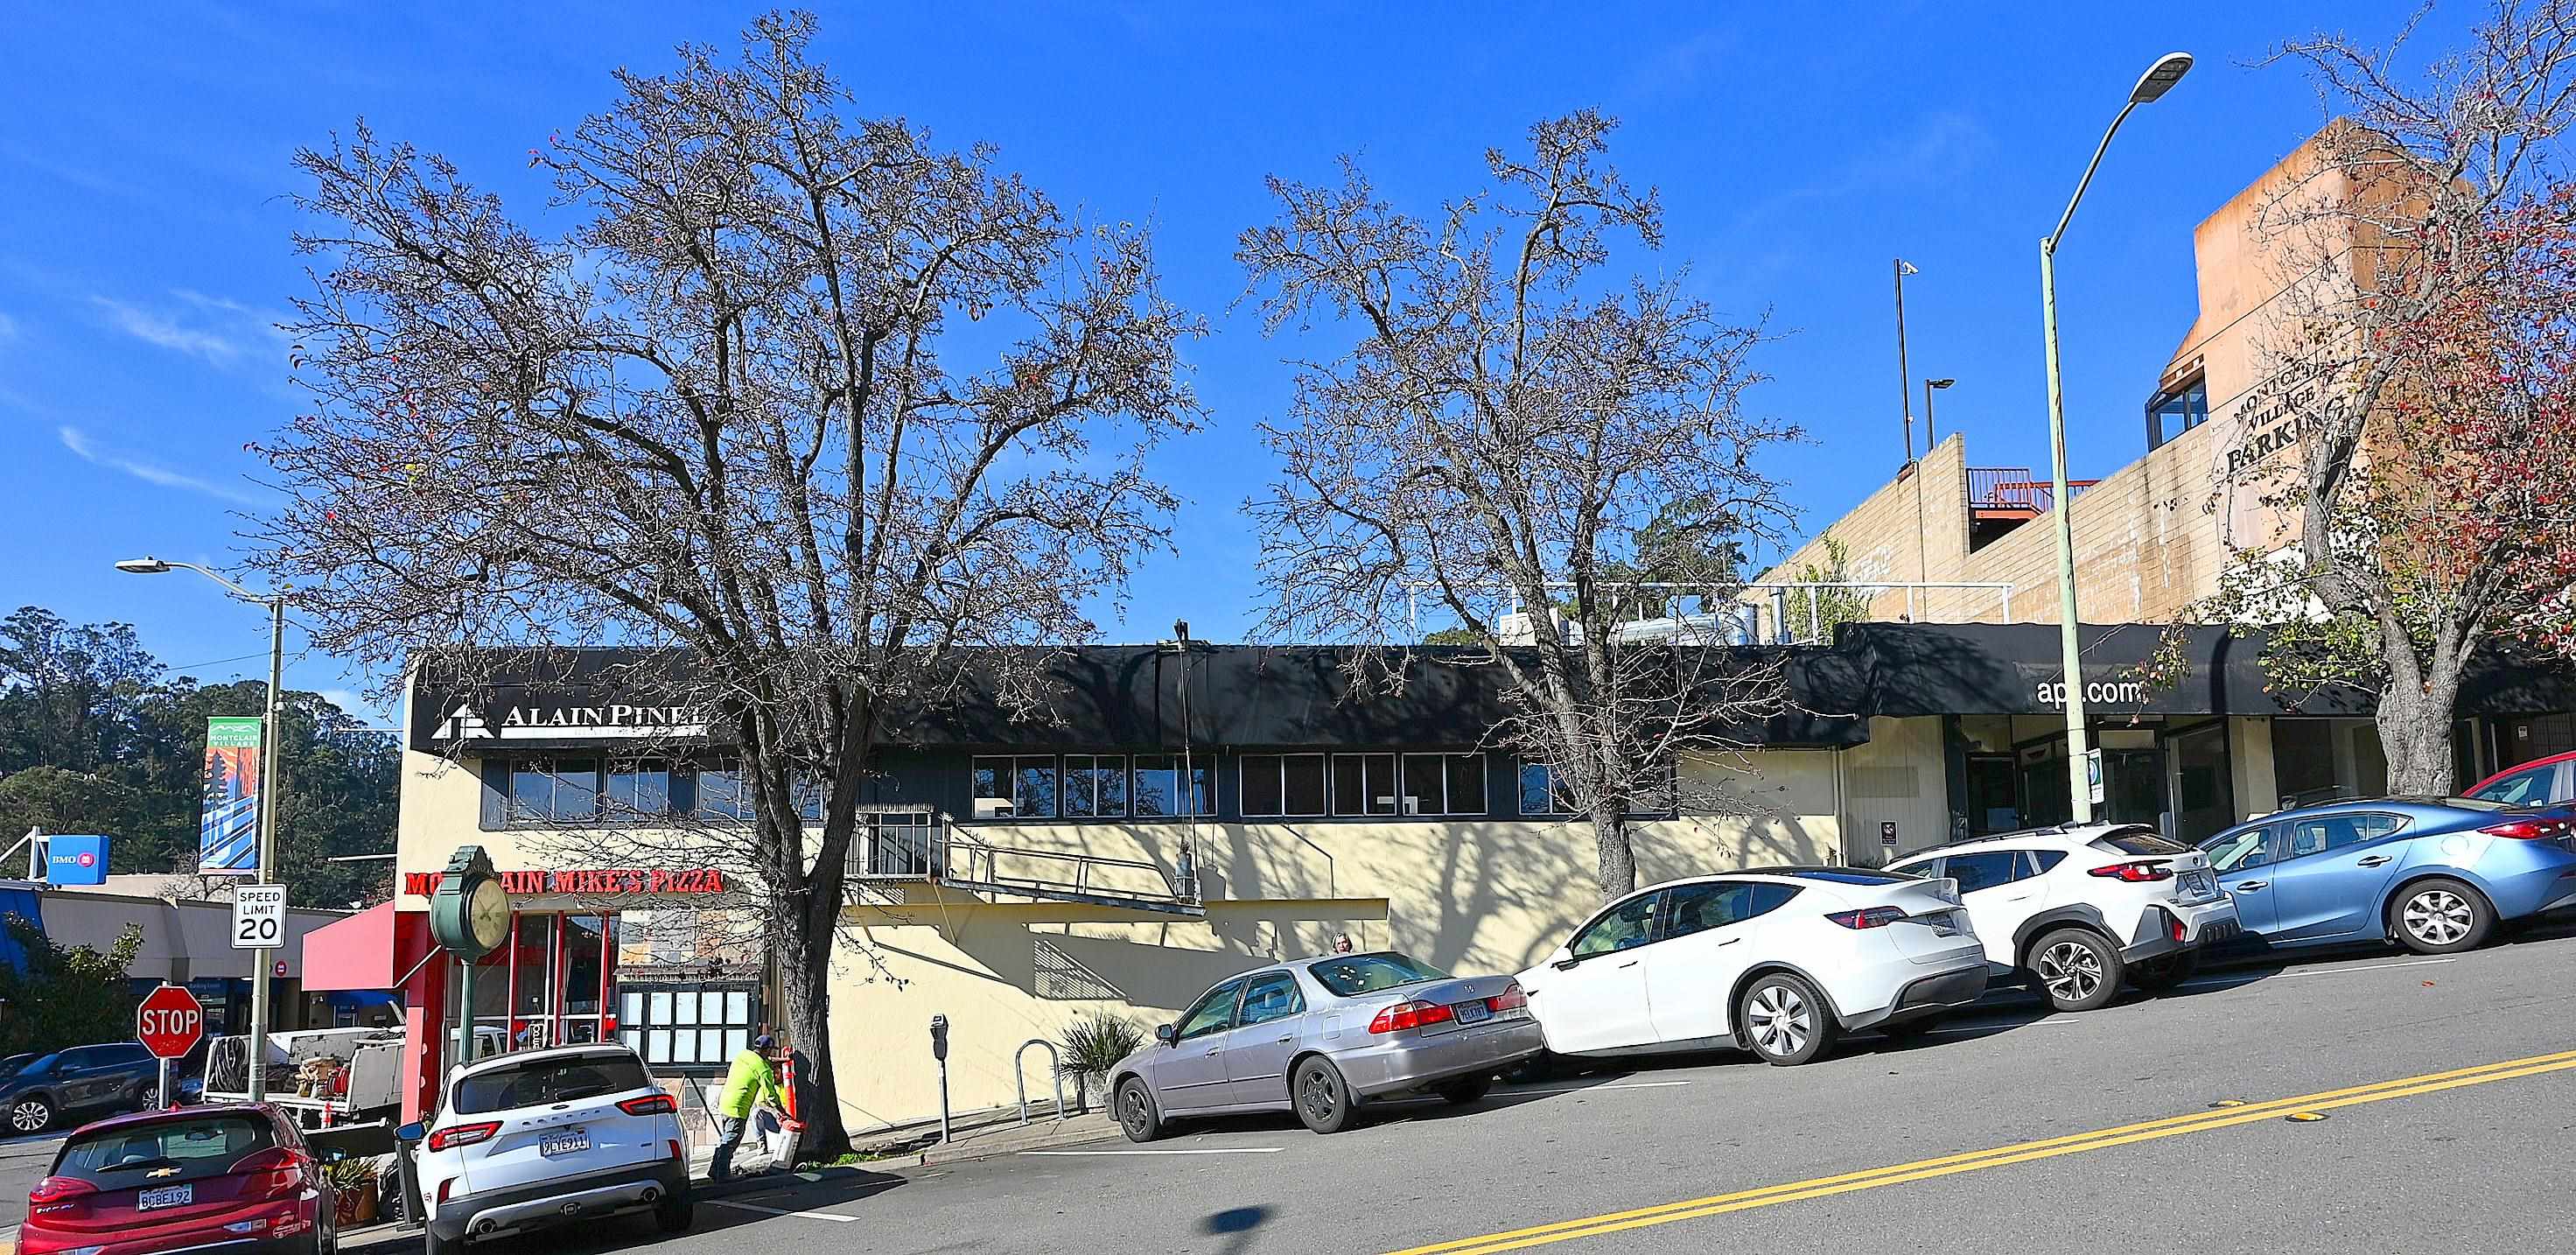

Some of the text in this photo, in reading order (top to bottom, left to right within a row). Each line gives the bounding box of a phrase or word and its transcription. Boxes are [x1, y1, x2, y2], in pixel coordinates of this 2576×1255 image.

[2249, 386, 2316, 431] VILLAGE
[2037, 682, 2141, 709] ap.com
[500, 705, 709, 726] ALAIN PINEL
[52, 855, 76, 864] BMO
[404, 872, 542, 894] MOAIN
[553, 870, 643, 893] MIKE'S
[240, 893, 280, 901] SPEED
[243, 905, 276, 915] LIMIT
[240, 918, 276, 939] 20
[142, 1009, 199, 1034] STOP
